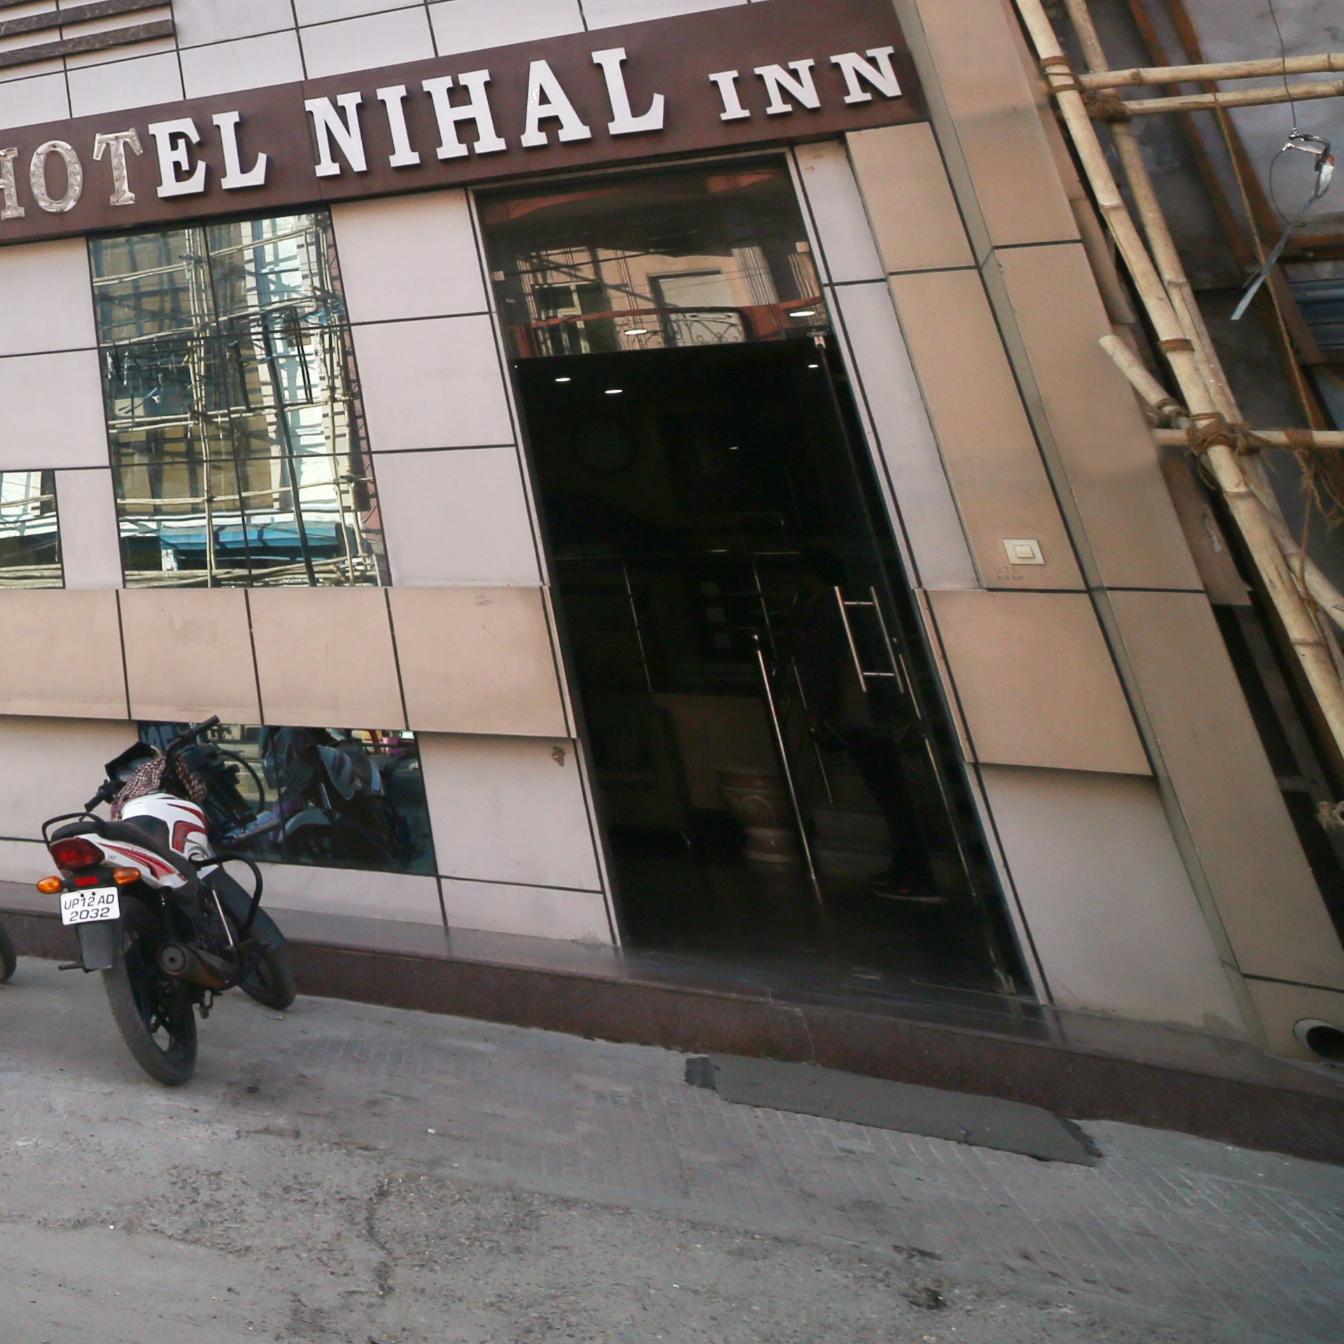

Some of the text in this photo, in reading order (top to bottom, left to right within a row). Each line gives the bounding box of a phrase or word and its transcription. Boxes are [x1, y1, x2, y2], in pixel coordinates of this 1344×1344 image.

[304, 47, 665, 178] NIHAL
[708, 46, 903, 121] INN
[69, 906, 110, 922] 2032
